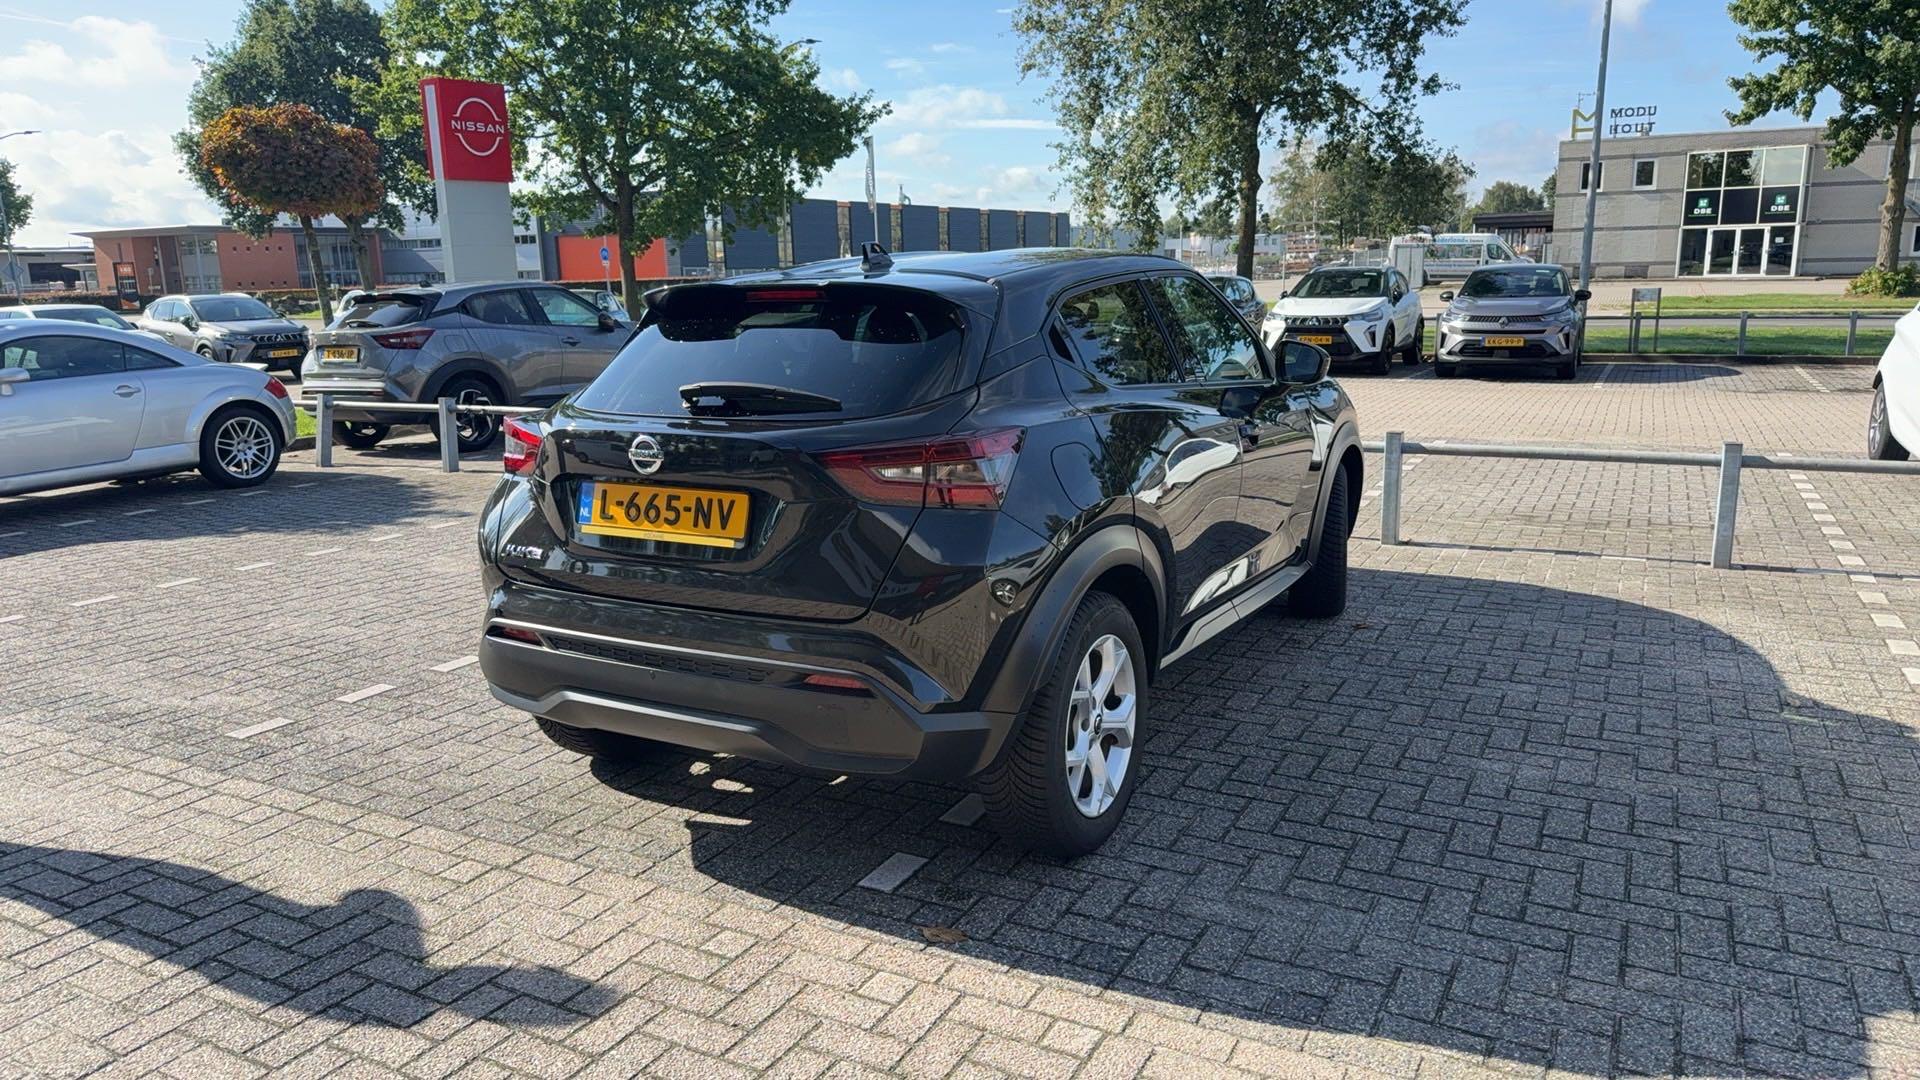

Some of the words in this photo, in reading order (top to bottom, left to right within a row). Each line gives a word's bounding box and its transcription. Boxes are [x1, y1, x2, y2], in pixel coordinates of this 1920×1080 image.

[1610, 105, 1657, 118] MODU
[451, 120, 504, 133] NISSAN
[1609, 122, 1656, 135] HOUT
[580, 507, 591, 517] NL
[600, 489, 736, 531] L-665-NV
